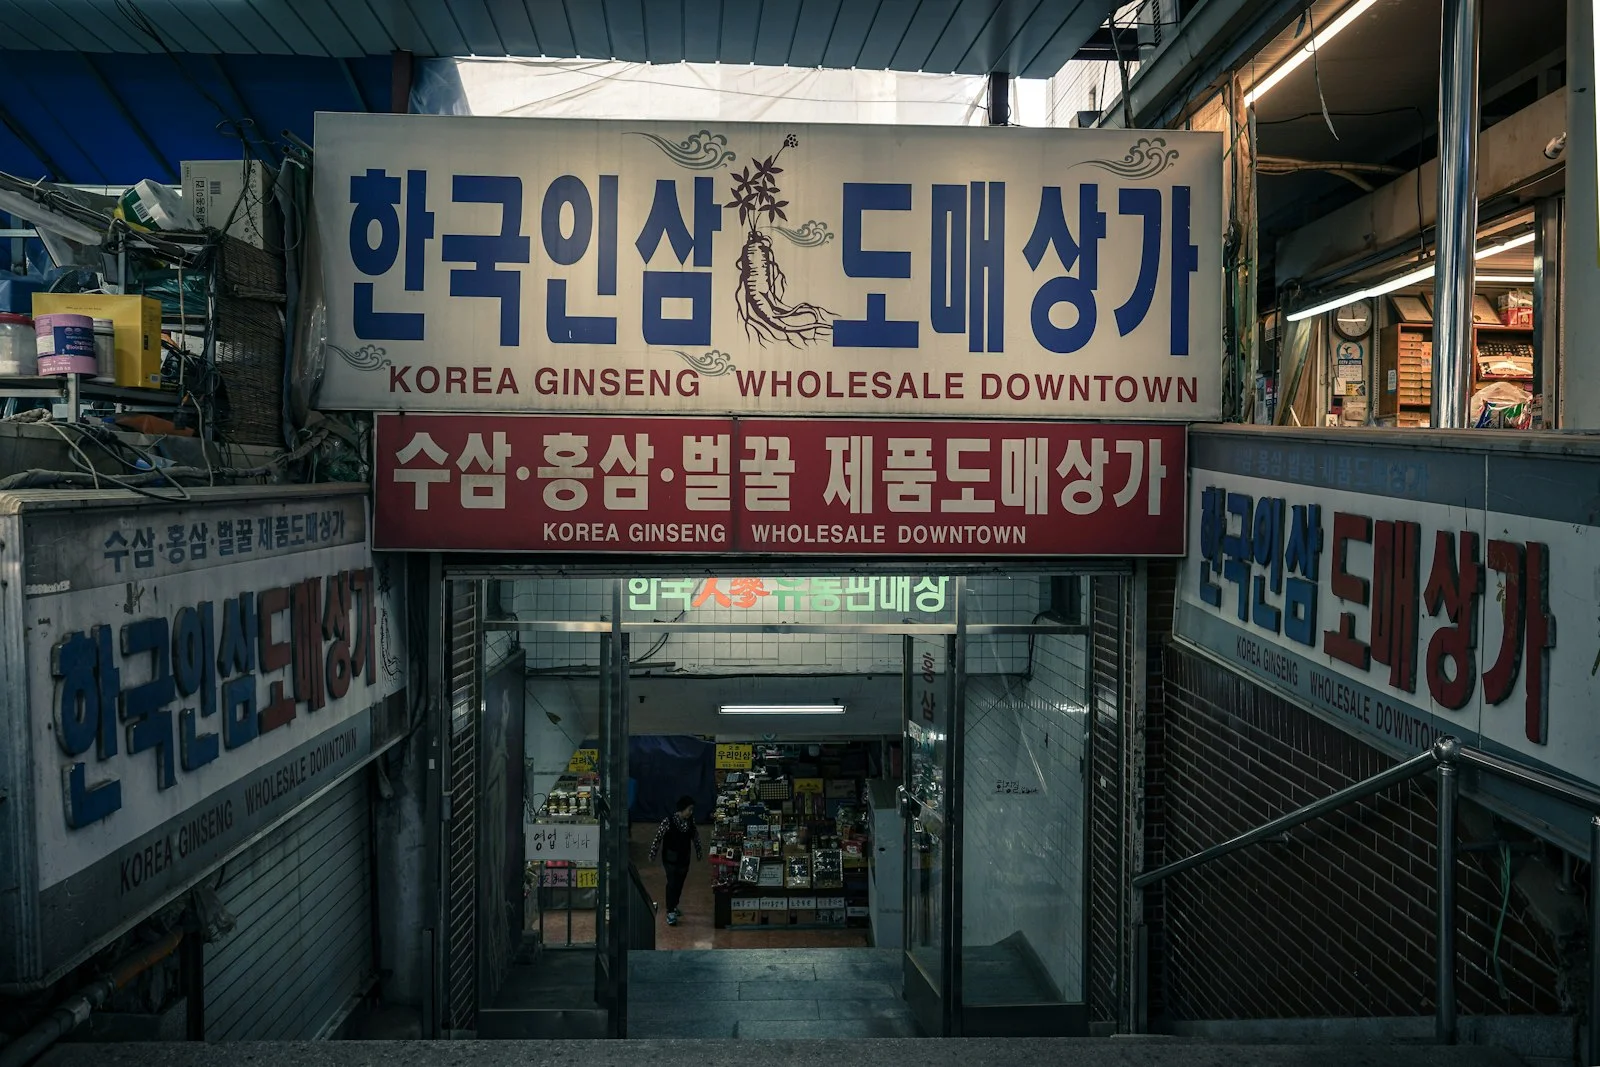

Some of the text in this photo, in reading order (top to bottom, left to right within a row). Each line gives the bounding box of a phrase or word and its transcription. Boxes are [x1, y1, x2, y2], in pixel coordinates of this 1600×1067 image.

[349, 168, 1199, 356] 한국인삼 도매상가
[389, 365, 1198, 404] KOREA GINSENG WHOLESALE DOWNTOWN
[822, 434, 1167, 516] 제품도매상가
[257, 509, 345, 551] 제품도매상가
[543, 523, 1026, 544] KOREA GINSENG WHOLESALE DOWNTOWN
[1236, 634, 1263, 672] KOREA
[1263, 647, 1299, 687] GINSENG
[1310, 670, 1371, 726] WHOLESALE
[717, 750, 751, 760] 우리인삼
[119, 727, 358, 895] KOREA GINSENG WHOLESALE DOWNTOWN
[534, 829, 591, 851] 영업 합니다
